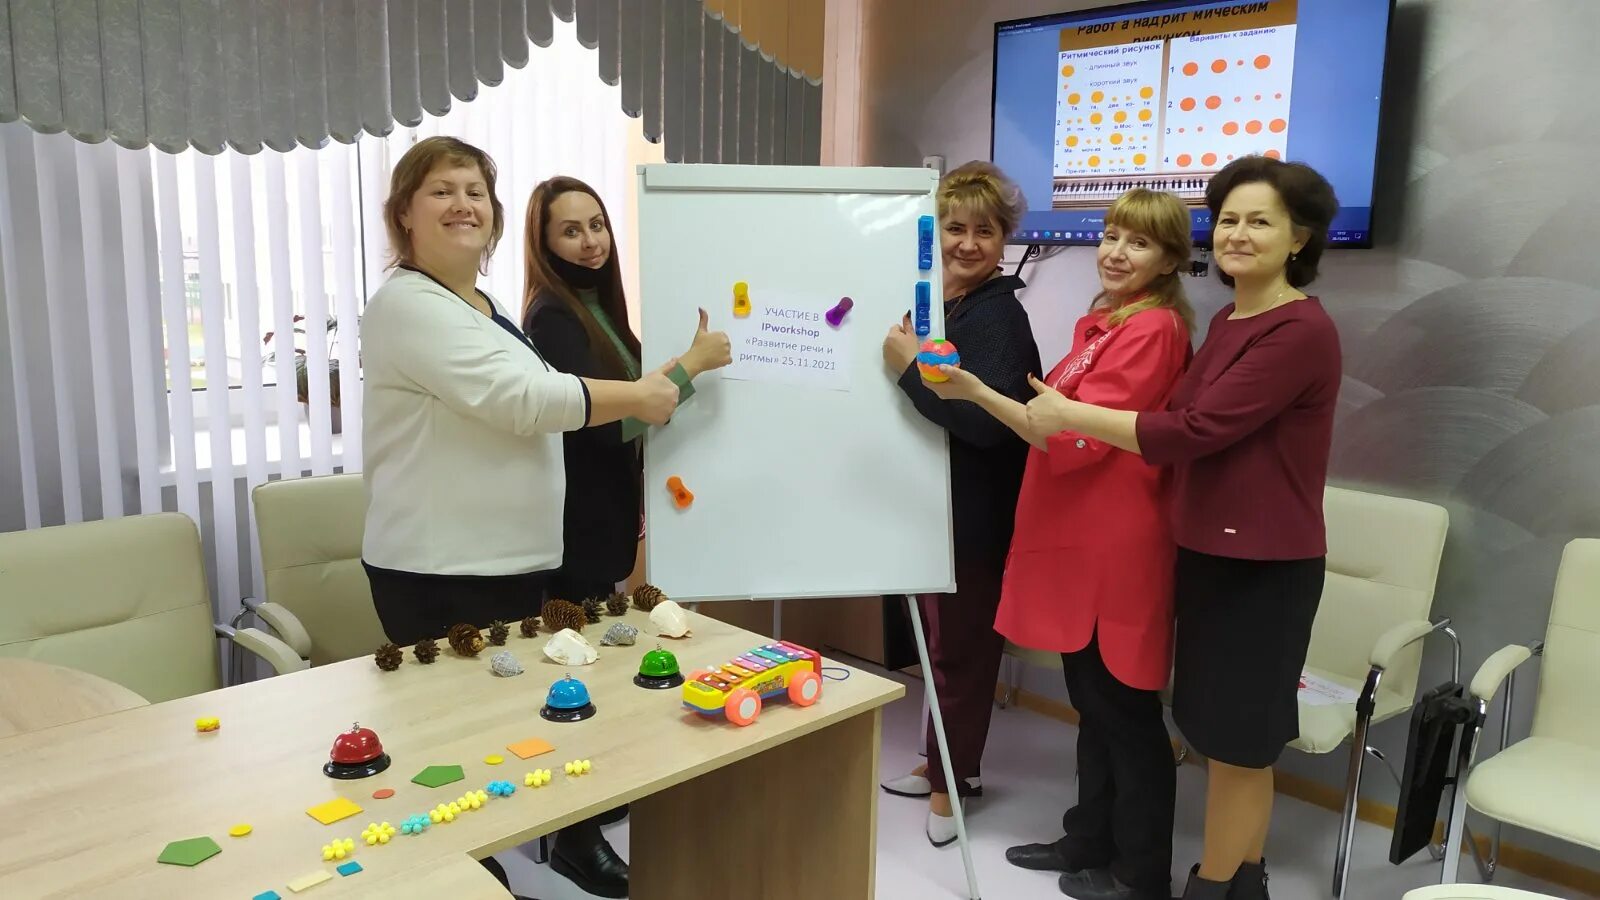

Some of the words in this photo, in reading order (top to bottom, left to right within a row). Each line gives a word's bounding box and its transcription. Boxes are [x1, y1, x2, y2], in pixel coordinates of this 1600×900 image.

[1239, 28, 1277, 37] заданию
[1061, 46, 1119, 60] Ритмический
[1122, 43, 1161, 55] рисунок
[765, 306, 811, 321] УЧАСТИЕ
[813, 312, 820, 322] В
[761, 322, 820, 339] IPworkshop
[745, 336, 798, 351] «Развитие
[800, 343, 824, 354] речи
[739, 352, 779, 364] ритмы»
[781, 356, 836, 371] 25.11.2021
